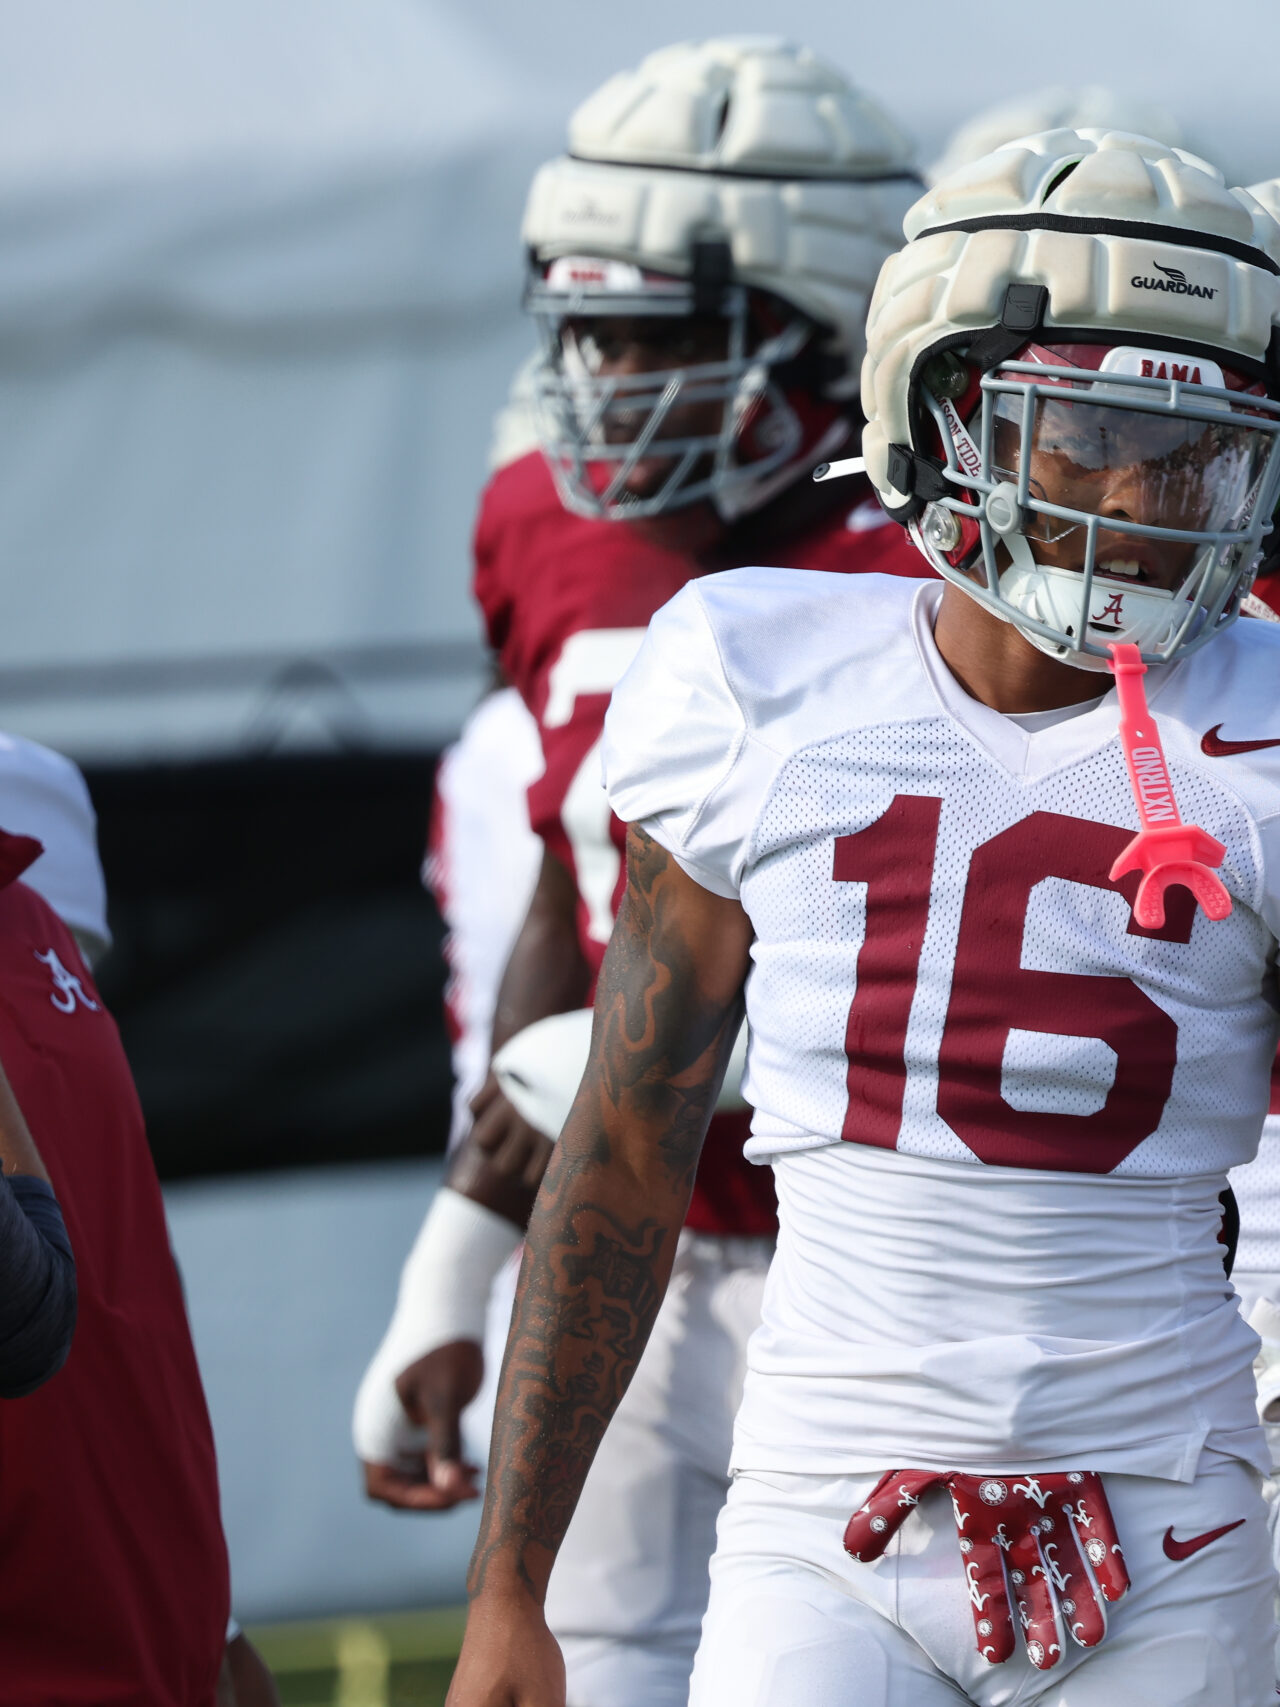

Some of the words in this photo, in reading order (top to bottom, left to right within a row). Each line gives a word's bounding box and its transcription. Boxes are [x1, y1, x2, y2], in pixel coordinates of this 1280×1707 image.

[1131, 276, 1214, 300] GUARDIAN
[1140, 359, 1203, 386] BAMA
[1091, 593, 1125, 625] A
[1131, 746, 1177, 823] NXTRND
[832, 793, 1179, 1174] 16
